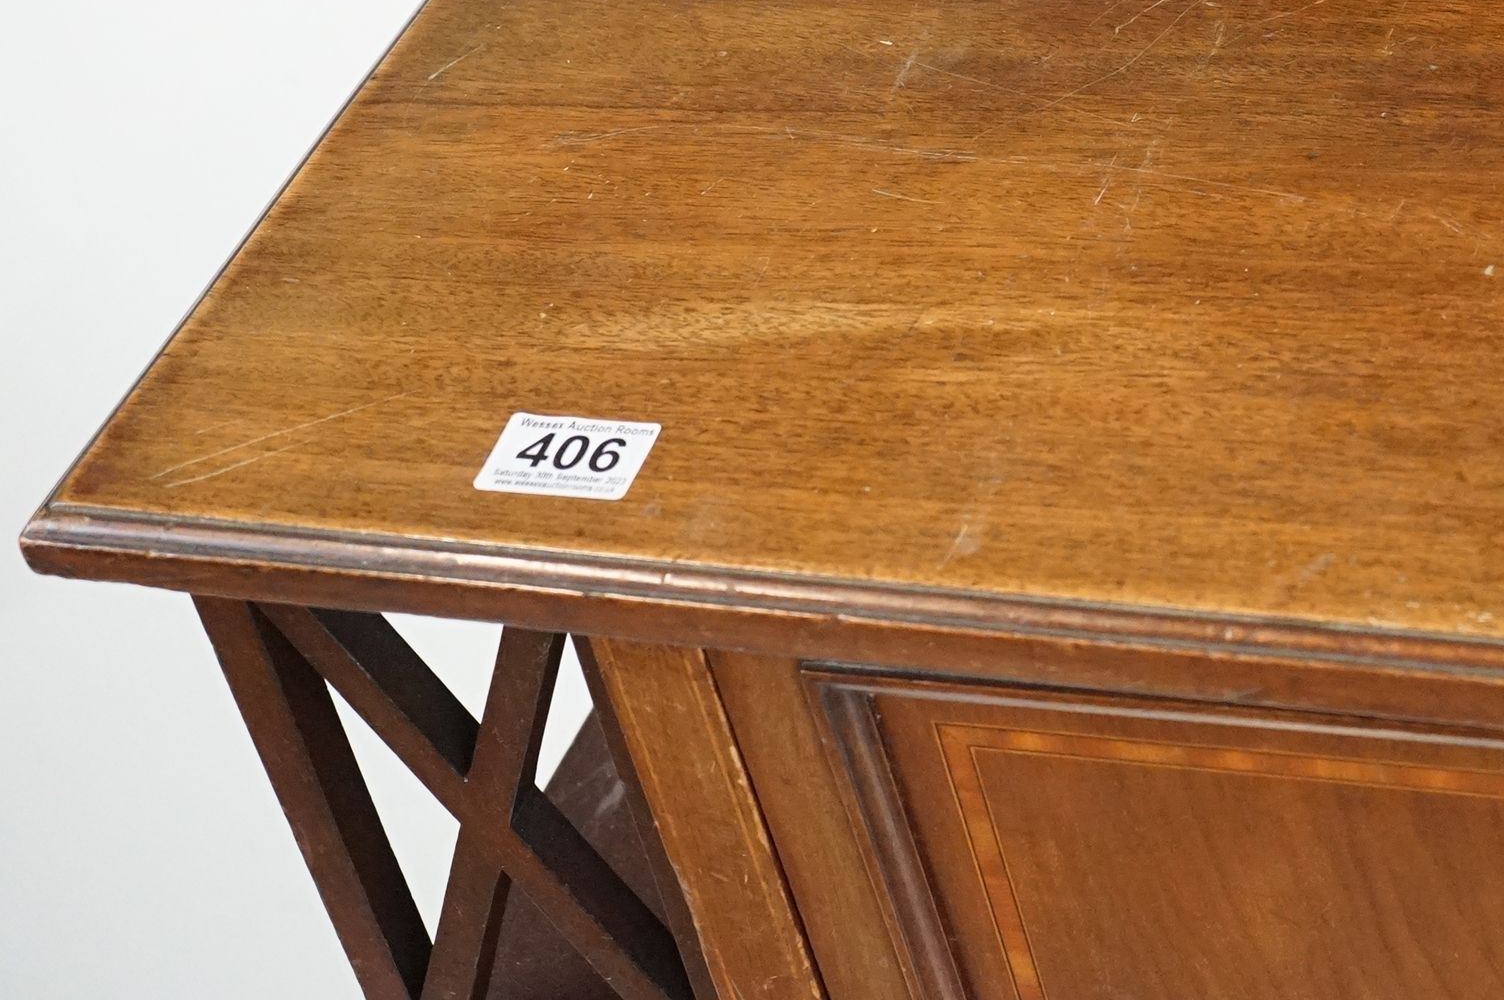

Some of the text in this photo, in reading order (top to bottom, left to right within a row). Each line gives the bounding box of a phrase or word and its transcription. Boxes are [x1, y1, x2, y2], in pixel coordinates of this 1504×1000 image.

[521, 418, 655, 436] Wessex Auction Rooms
[516, 433, 627, 473] 406
